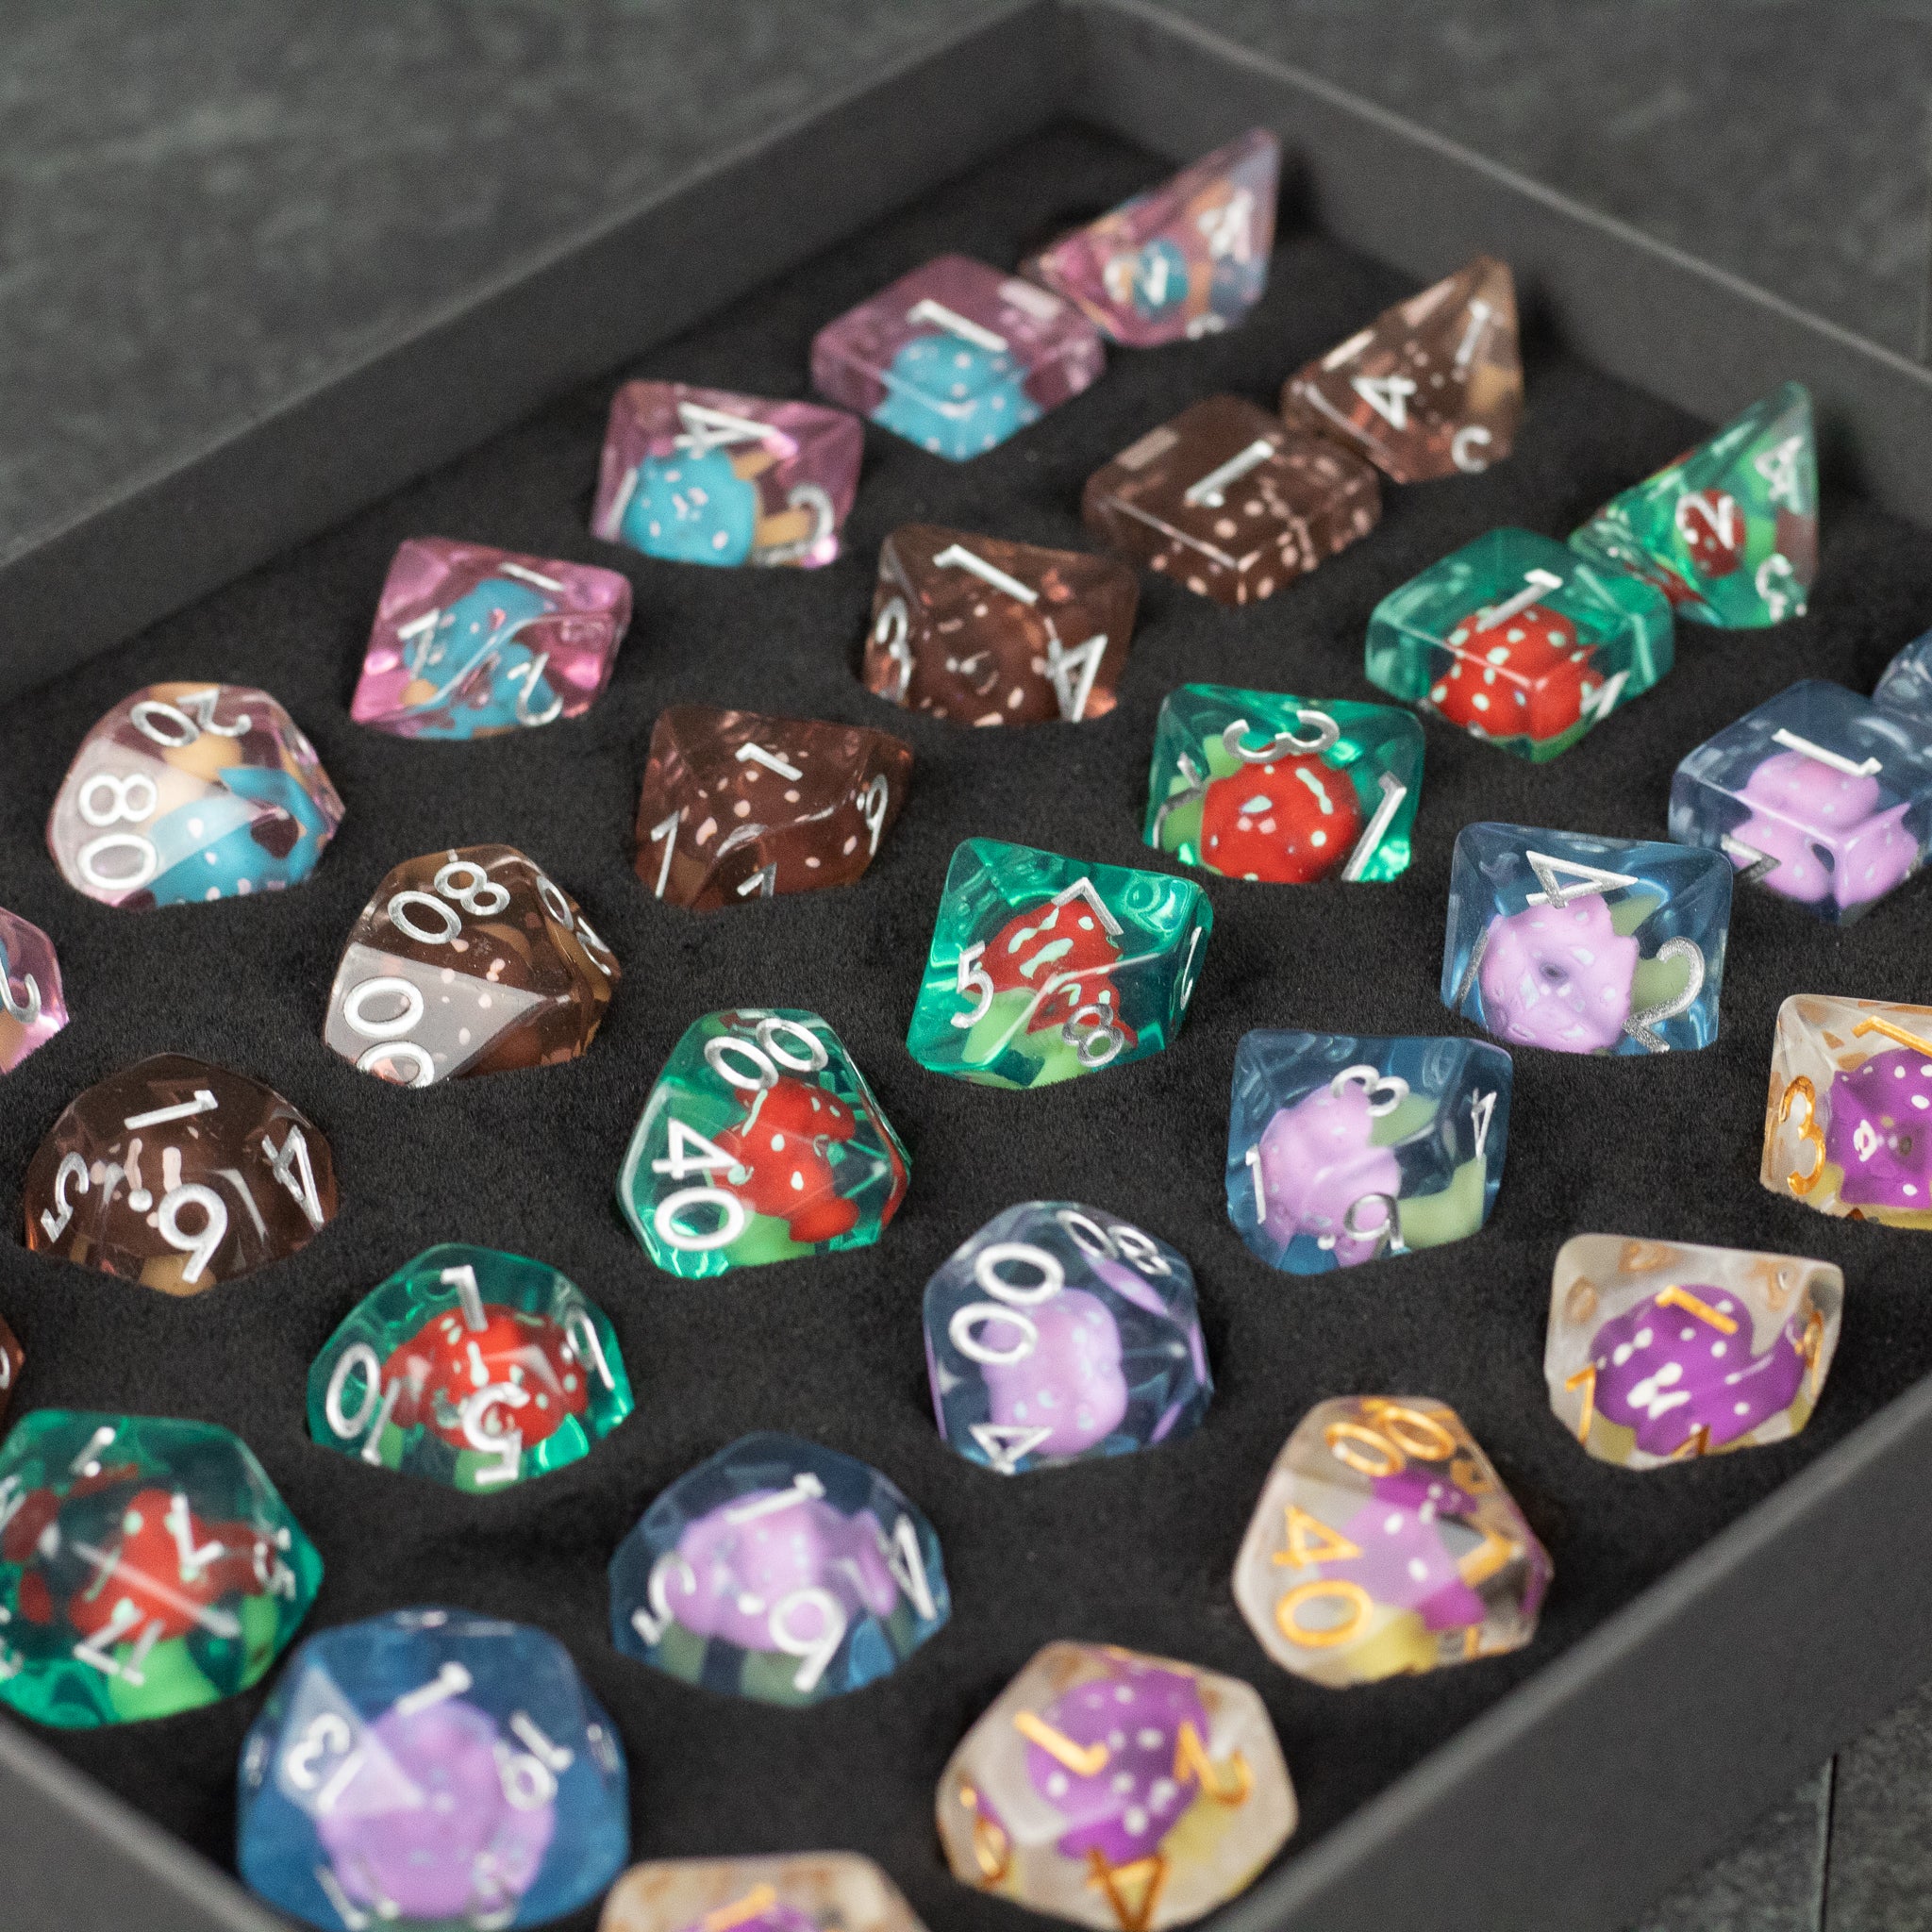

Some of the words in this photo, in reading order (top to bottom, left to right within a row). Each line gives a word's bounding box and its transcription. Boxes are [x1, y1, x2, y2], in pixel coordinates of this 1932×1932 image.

[907, 299, 1007, 352] 1
[933, 542, 1039, 606] 1
[1475, 567, 1563, 634] 1
[734, 741, 804, 782] 1
[1222, 708, 1341, 764] 3
[1770, 727, 1883, 779] 1
[77, 773, 158, 891] 80
[386, 859, 511, 945] 80
[1524, 849, 1639, 910] 4
[950, 940, 994, 1029] 5
[1621, 935, 1705, 1054] 2
[704, 1017, 829, 1091] 00
[1061, 1002, 1126, 1069] 8
[124, 1089, 219, 1131] 1
[1330, 1063, 1411, 1118] 3
[1777, 1074, 1827, 1196] 3
[260, 1124, 325, 1232] 4
[651, 1117, 746, 1252] 40
[1244, 1143, 1266, 1225] 1
[948, 1242, 1066, 1367] 00
[1654, 1284, 1740, 1336] 1
[461, 1380, 531, 1487] 5
[1324, 1405, 1457, 1478] 00
[724, 1472, 827, 1525] 1
[1271, 1504, 1374, 1649] 40
[393, 1660, 474, 1719] 1
